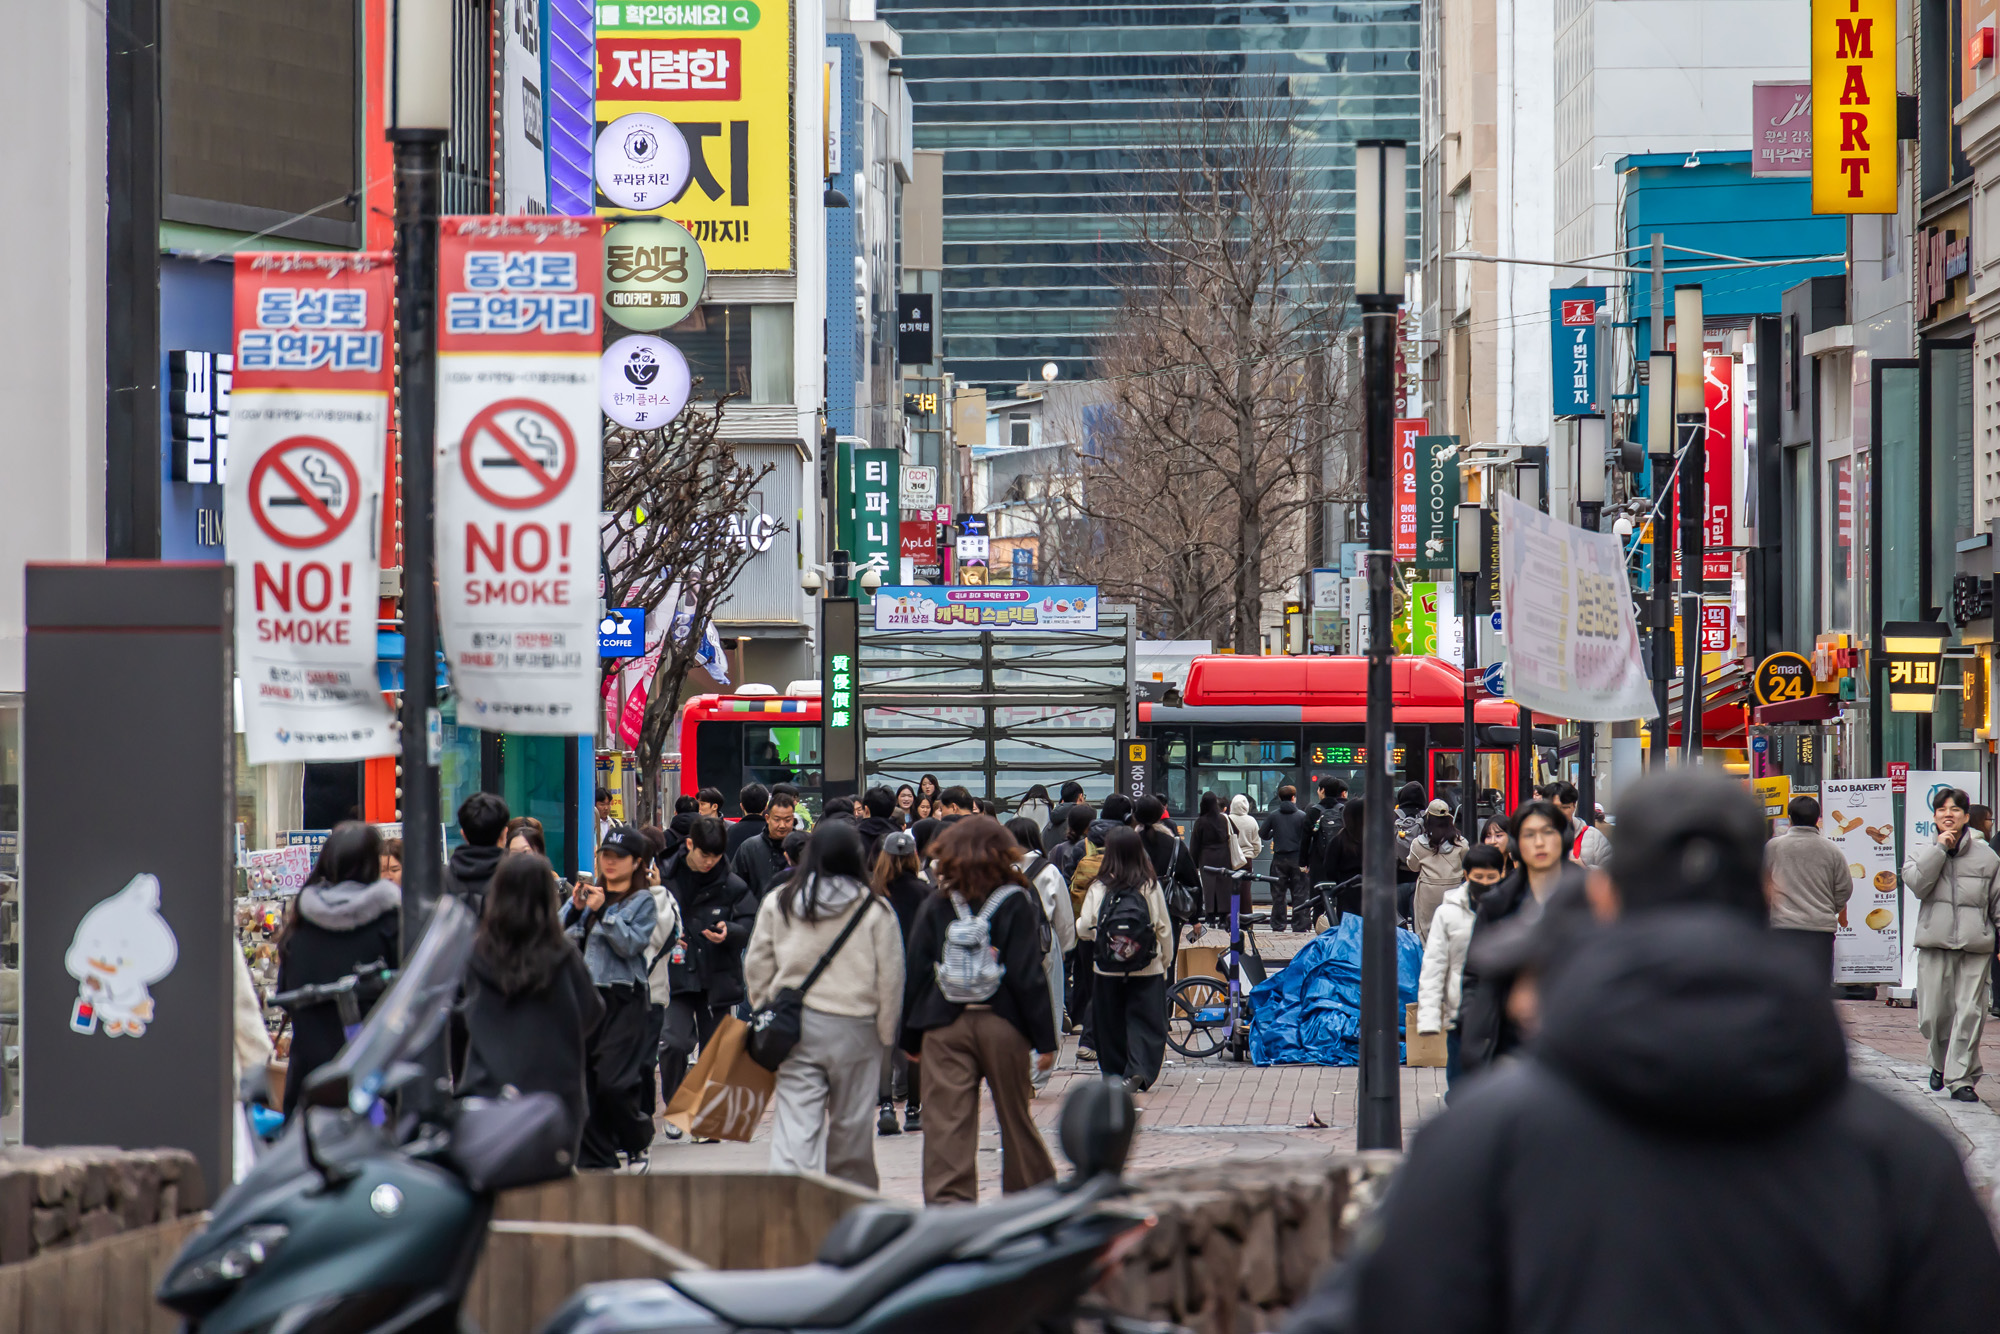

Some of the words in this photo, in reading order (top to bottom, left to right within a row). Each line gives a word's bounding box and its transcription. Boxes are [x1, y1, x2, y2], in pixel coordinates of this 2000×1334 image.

[596, 5, 620, 26] 를
[625, 4, 727, 26] 확인하세요!
[612, 49, 729, 90] 저렴한
[1764, 130, 1787, 144] 황실
[613, 173, 645, 186] 푸라닭
[647, 173, 669, 186] 치킨
[633, 192, 648, 203] 5F
[466, 253, 574, 290] 동성로
[259, 290, 365, 328] 동성로
[613, 293, 652, 306] 베이커리
[660, 293, 681, 306] 카페
[449, 294, 592, 332] 금연거리
[899, 322, 930, 332] 연기학원
[239, 332, 382, 371] 금연거리
[1573, 327, 1589, 404] 7번가피자
[613, 391, 670, 406] 한끼플러스
[635, 411, 649, 422] 2F
[909, 471, 928, 480] CCR
[1401, 504, 1416, 513] 아이
[1430, 444, 1444, 553] CROCODIL
[1401, 515, 1416, 523] 오디
[1401, 524, 1416, 534] 입시
[865, 461, 890, 605] 티파니주
[464, 521, 572, 574] NO!
[253, 562, 352, 613] NO!
[465, 579, 570, 606] SMOKE
[888, 614, 909, 624] 22개
[911, 614, 929, 624] 상점
[935, 604, 981, 625] 캐릭터
[981, 607, 1038, 626] 스트리트
[257, 619, 351, 645] SMOKE
[603, 639, 632, 647] COFFEE
[1769, 664, 1803, 675] emart
[1890, 661, 1936, 684] 커피
[831, 654, 850, 728] 質優價廉
[1768, 676, 1805, 702] 24
[1131, 765, 1145, 799] 중앙
[1828, 784, 1848, 793] SAO
[1849, 783, 1886, 792] BAKERY
[1765, 806, 1782, 816] EW
